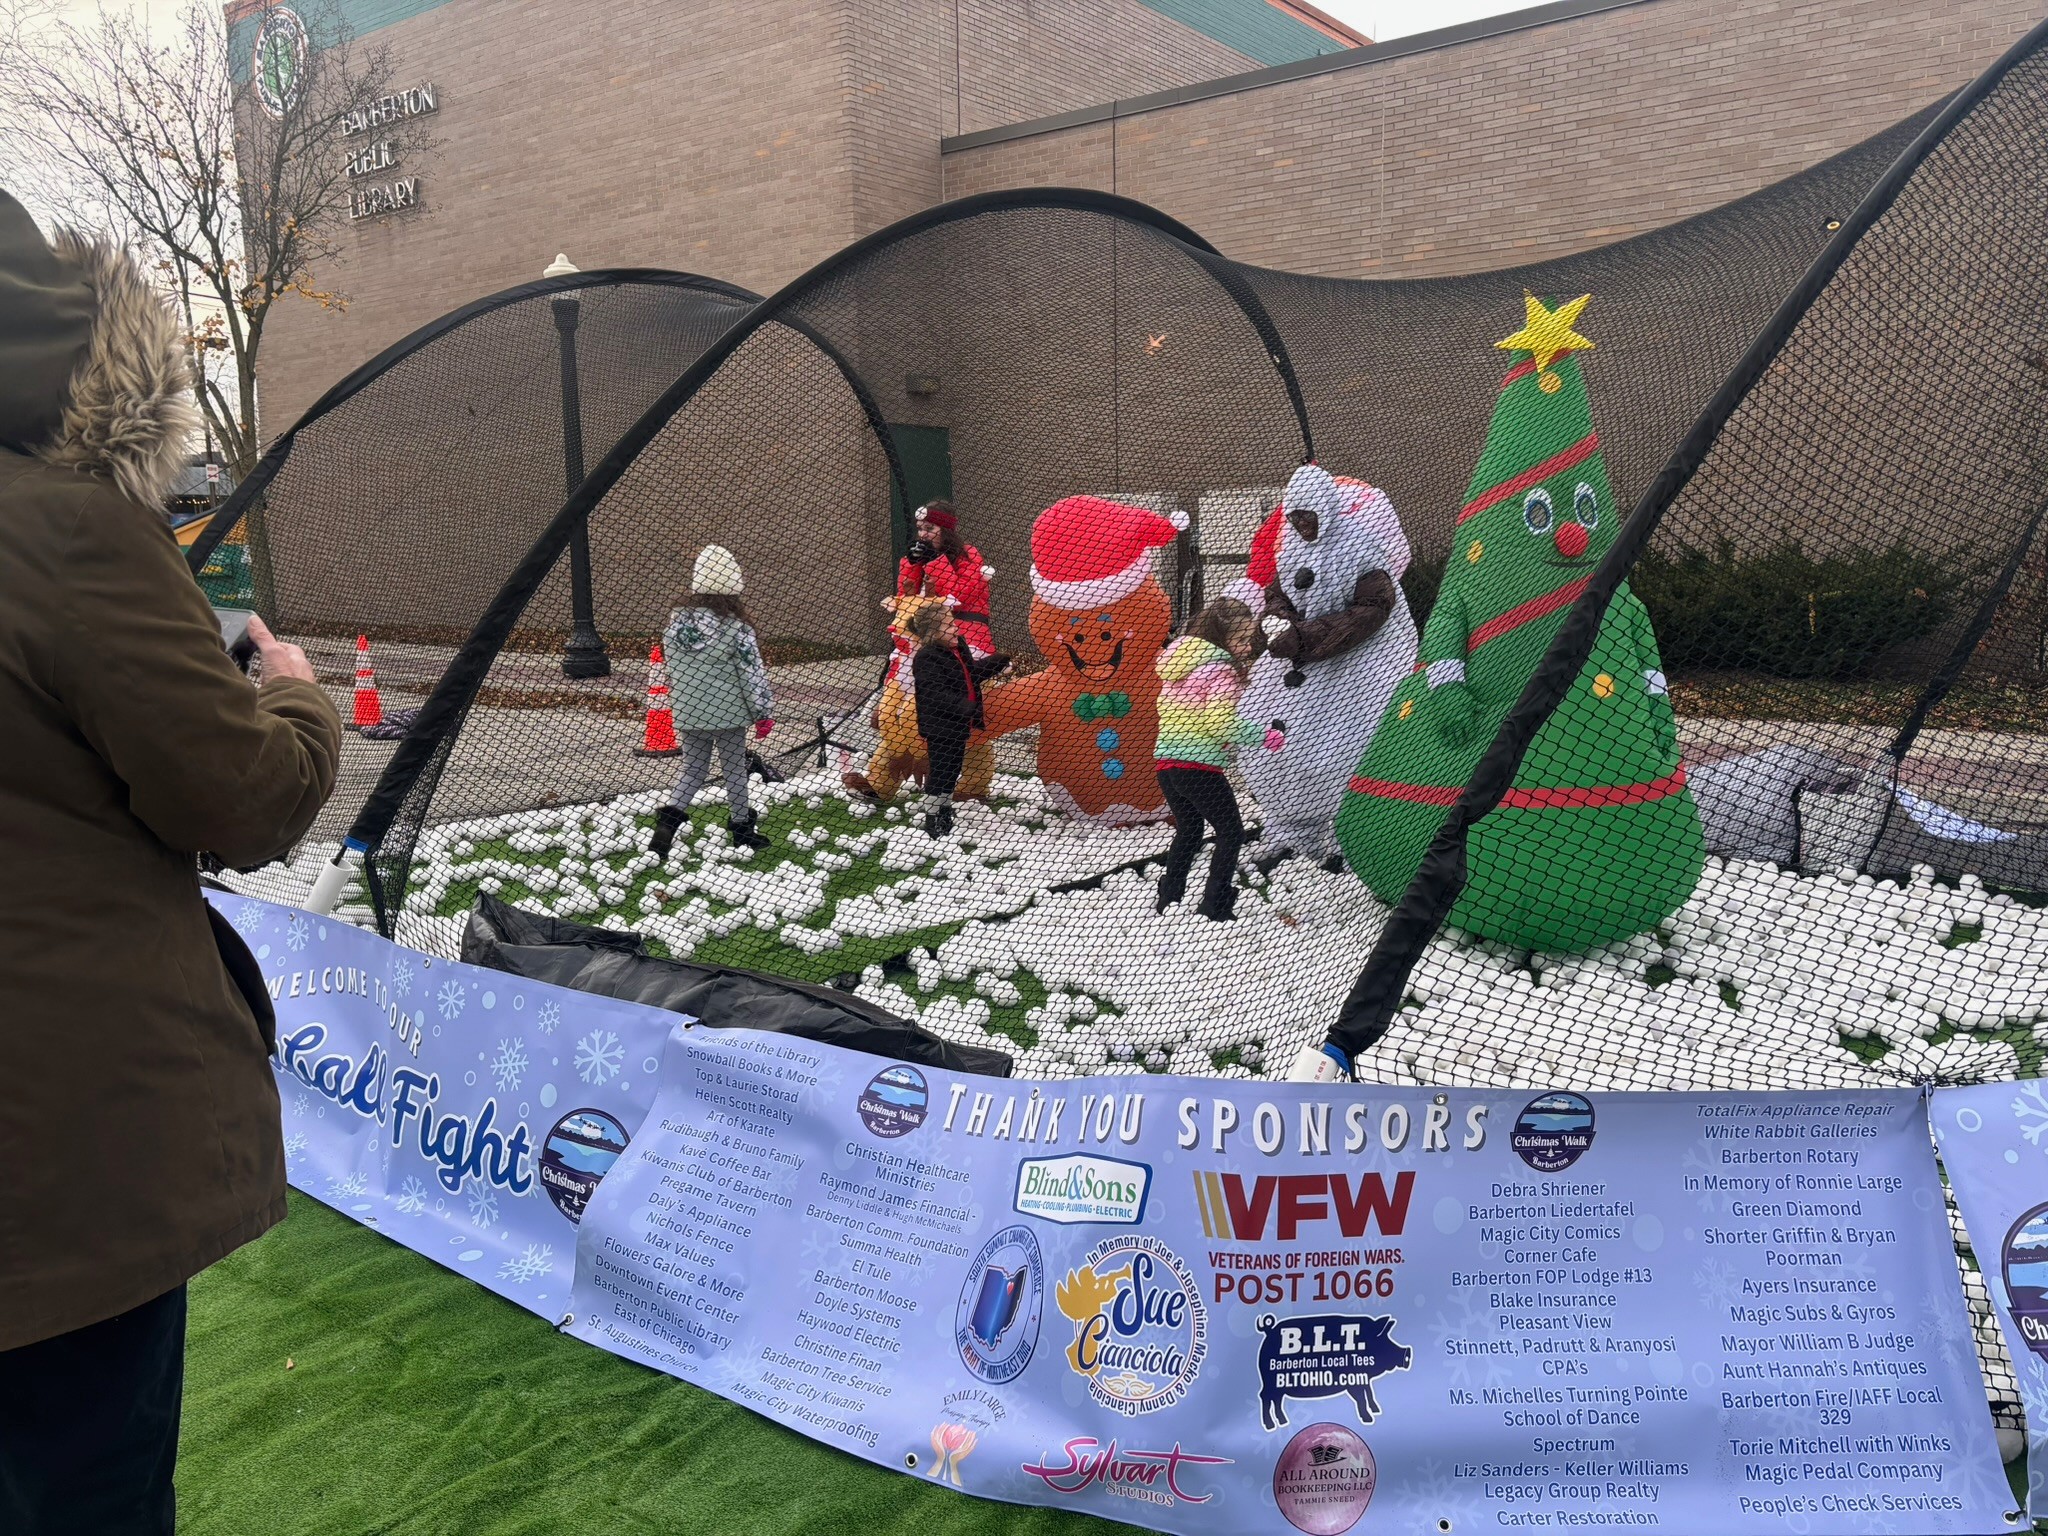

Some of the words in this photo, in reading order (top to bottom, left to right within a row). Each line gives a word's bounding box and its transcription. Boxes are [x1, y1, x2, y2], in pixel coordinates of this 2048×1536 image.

[342, 82, 438, 136] BARBERTON
[345, 140, 397, 177] PUBLIC
[349, 178, 418, 219] LIBRARY
[266, 966, 368, 1000] WELCOME
[375, 978, 387, 1011] TO
[389, 1002, 422, 1059] OUR
[687, 1046, 736, 1069] Snowball
[738, 1057, 773, 1076] Books
[775, 1066, 783, 1078] &
[786, 1068, 818, 1087] More
[695, 1088, 726, 1106] Helen
[728, 1096, 757, 1114] Scott
[759, 1104, 793, 1126] Realty
[1696, 1105, 1757, 1117] TotalFix
[1761, 1104, 1840, 1120] Appliance
[1844, 1103, 1895, 1119] Repair
[392, 1066, 535, 1197] Fight
[943, 1082, 1066, 1144] THANK
[1078, 1093, 1145, 1144] YOU
[1178, 1098, 1488, 1157] SPONSORS
[1704, 1125, 1750, 1139] White
[1754, 1124, 1806, 1139] Rabbit
[1810, 1123, 1878, 1138] Galleries
[1514, 1135, 1559, 1147] Christmas
[1562, 1134, 1587, 1146] Walk
[845, 1142, 903, 1168] Christian
[906, 1158, 970, 1184] Healthcare
[1532, 1156, 1569, 1169] Barberton
[1721, 1149, 1802, 1164] Barberton
[1806, 1149, 1859, 1167] Rotary
[542, 1166, 586, 1194] Christmas
[875, 1165, 936, 1193] Ministries
[1491, 1182, 1537, 1198] Debra
[1541, 1181, 1606, 1197] Shriener
[1684, 1175, 1699, 1191] In
[1704, 1175, 1770, 1194] Memory
[1775, 1174, 1792, 1190] of
[1795, 1174, 1853, 1190] Ronnie
[1857, 1174, 1903, 1194] Large
[660, 1175, 712, 1202] Pregame
[716, 1192, 757, 1217] Tavern
[1221, 1171, 1416, 1241] VFW
[1469, 1204, 1546, 1220] Barberton
[1550, 1202, 1635, 1218] Liedertafel
[1732, 1201, 1782, 1217] Green
[1786, 1200, 1862, 1217] Diamond
[646, 1211, 693, 1238] Nichols
[695, 1229, 735, 1253] Fence
[806, 1203, 864, 1231] Barberton
[866, 1222, 904, 1244] Comm.
[907, 1233, 969, 1259] Foundation
[1480, 1226, 1525, 1245] Magic
[1529, 1225, 1560, 1244] City
[1564, 1225, 1621, 1240] Comics
[644, 1231, 672, 1250] Max
[674, 1242, 716, 1269] Values
[840, 1233, 881, 1256] Summa
[884, 1246, 922, 1267] Health
[1208, 1251, 1281, 1270] VETERANS
[1285, 1253, 1301, 1269] OF
[1305, 1250, 1360, 1268] FOREIGN
[1504, 1249, 1557, 1263] Corner
[1561, 1247, 1597, 1262] Cafe
[851, 1259, 866, 1273] El
[867, 1263, 892, 1282] Tule
[1452, 1270, 1531, 1286] Barberton
[1536, 1269, 1567, 1284] FOP
[1572, 1269, 1620, 1287] Lodge
[1624, 1268, 1653, 1283] #13
[595, 1254, 654, 1291] Downtown
[656, 1281, 692, 1307] Event
[695, 1297, 740, 1325] Center
[813, 1269, 874, 1300] Barberton
[876, 1289, 918, 1312] Moose
[1112, 1252, 1187, 1336] Sue
[1214, 1272, 1305, 1305] POST
[1312, 1268, 1394, 1301] 1066
[1742, 1278, 1790, 1298] Ayers
[1793, 1277, 1877, 1293] Insurance
[814, 1291, 849, 1314] Doyle
[850, 1302, 902, 1330] Systems
[1490, 1292, 1534, 1308] Blake
[1537, 1292, 1617, 1307] Insurance
[594, 1274, 648, 1310] Barberton
[650, 1301, 684, 1329] Public
[686, 1319, 732, 1351] Library
[1499, 1313, 1569, 1330] Pleasant
[1573, 1313, 1612, 1329] View
[614, 1303, 637, 1325] East
[639, 1315, 651, 1331] of
[652, 1320, 696, 1356] Chicago
[796, 1309, 854, 1338] Haywood
[853, 1327, 901, 1354] Electric
[1279, 1323, 1366, 1355] B.L.T.
[793, 1334, 847, 1362] Christine
[847, 1351, 882, 1373] Finan
[1078, 1314, 1183, 1376] Cianciola
[760, 1346, 820, 1376] Barberton
[821, 1366, 846, 1385] Tree
[847, 1375, 893, 1398] Service
[1269, 1358, 1318, 1371] Barberton
[1321, 1355, 1348, 1368] Local
[1351, 1353, 1375, 1366] Tees
[1722, 1361, 1766, 1380] Aunt
[1852, 1359, 1927, 1379] Antiques
[1276, 1370, 1369, 1388] BLTOHIO.com
[759, 1371, 795, 1391] Magic
[795, 1382, 821, 1402] City
[820, 1391, 866, 1413] Kiwanis
[1449, 1389, 1479, 1404] Ms.
[1482, 1387, 1563, 1404] Michelles
[1566, 1386, 1631, 1405] Turning
[1635, 1386, 1688, 1401] Pointe
[1721, 1391, 1811, 1410] Barberton
[1815, 1388, 1893, 1408] Fire/IAFF
[1896, 1386, 1943, 1404] Local
[943, 1390, 982, 1406] EMILY
[979, 1391, 1007, 1422] LARGE
[1504, 1410, 1562, 1427] School
[1566, 1409, 1582, 1425] of
[1587, 1409, 1640, 1424] Dance
[1819, 1408, 1851, 1425] 329
[1533, 1437, 1615, 1455] Spectrum
[1729, 1438, 1774, 1457] Torie
[1778, 1436, 1852, 1455] Mitchell
[1854, 1436, 1894, 1453] with
[1897, 1434, 1951, 1453] Winks
[1022, 1436, 1235, 1503] Sylvart
[1280, 1469, 1305, 1481] ALL
[1309, 1467, 1370, 1480] AROUND
[1745, 1463, 1799, 1484] Magic
[1803, 1462, 1854, 1481] Pedal
[1858, 1462, 1943, 1483] Company
[1278, 1482, 1351, 1494] BOOKKEEPING
[1353, 1481, 1372, 1490] LLC
[1485, 1483, 1543, 1502] Legacy
[1549, 1482, 1601, 1502] Group
[1606, 1482, 1660, 1502] Realty
[1294, 1497, 1326, 1505] TAMMIE
[1821, 1493, 1879, 1513] Check
[1883, 1492, 1963, 1511] Services
[1497, 1511, 1552, 1526] Carter
[1557, 1510, 1659, 1525] Restoration
